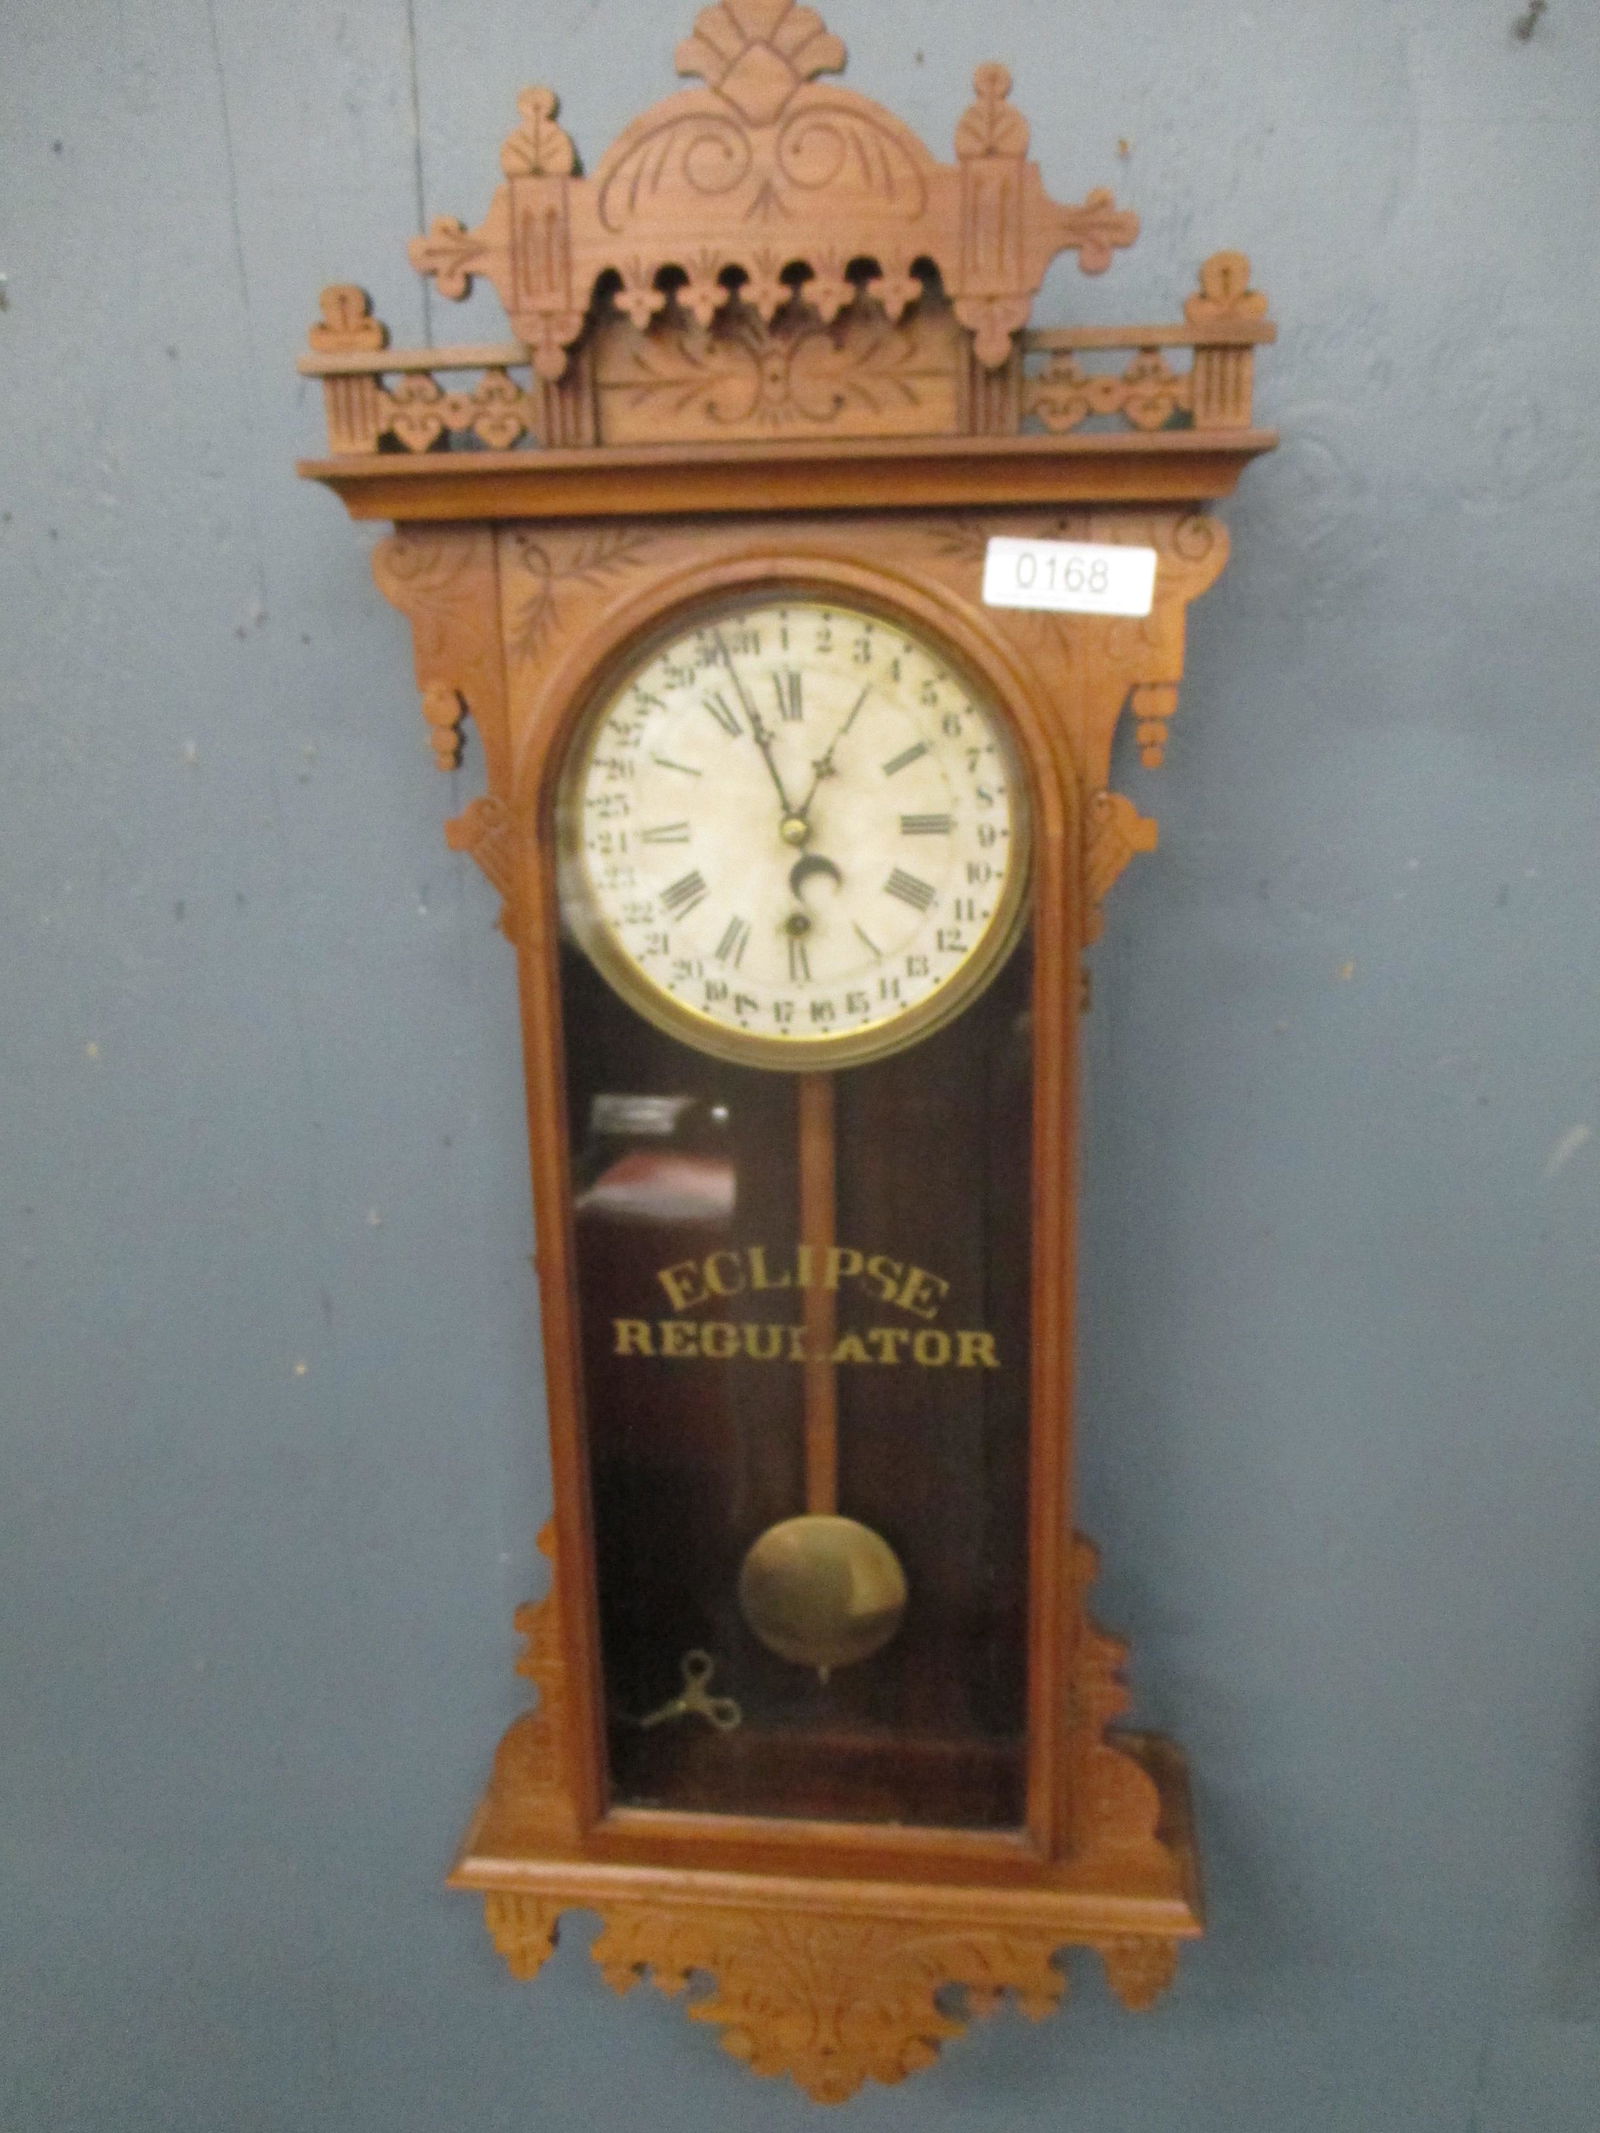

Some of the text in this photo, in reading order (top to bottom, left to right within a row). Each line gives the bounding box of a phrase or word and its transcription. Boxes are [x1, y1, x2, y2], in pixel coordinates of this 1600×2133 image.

[1015, 551, 1109, 593] 0168
[780, 627, 790, 651] 1
[816, 628, 832, 652] 2
[853, 638, 872, 664] 3
[920, 680, 939, 706] 5
[942, 713, 962, 737] 6
[966, 748, 981, 773] 7
[901, 814, 953, 836] III
[978, 823, 997, 848] 9
[967, 862, 992, 885] 10
[955, 898, 975, 922] 11
[937, 928, 968, 952] 12
[907, 955, 930, 978] 13
[774, 1001, 795, 1023] 17
[810, 1000, 836, 1024] 16
[846, 991, 870, 1014] 15
[657, 1244, 950, 1319] ECLIPSE
